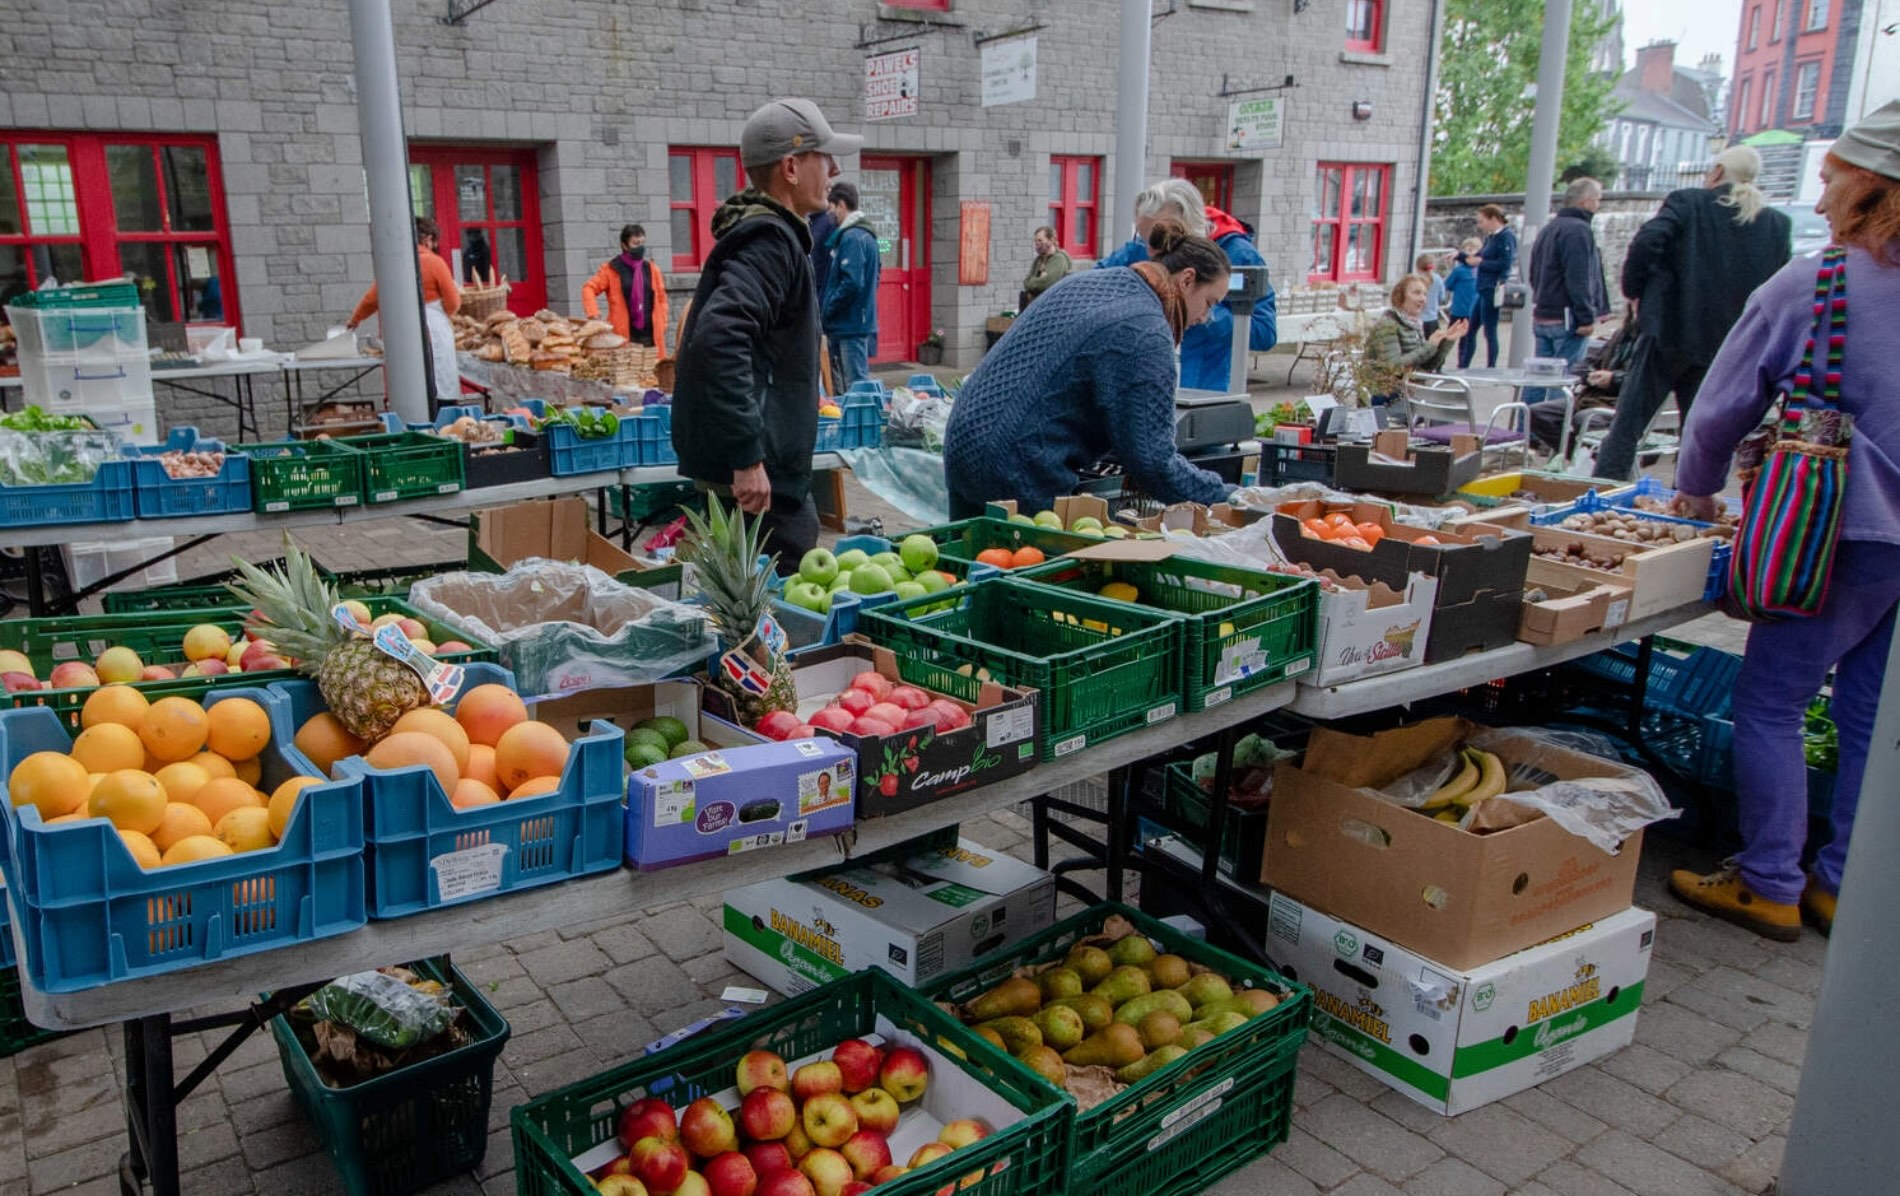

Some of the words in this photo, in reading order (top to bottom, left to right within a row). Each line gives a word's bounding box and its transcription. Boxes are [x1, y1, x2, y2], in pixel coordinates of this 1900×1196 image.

[866, 52, 917, 76] PAWELS
[866, 79, 897, 97] SHOE
[866, 98, 917, 116] REPAIRS
[770, 906, 844, 966] BANAMIEL
[1527, 976, 1600, 1024] BANAMIEL
